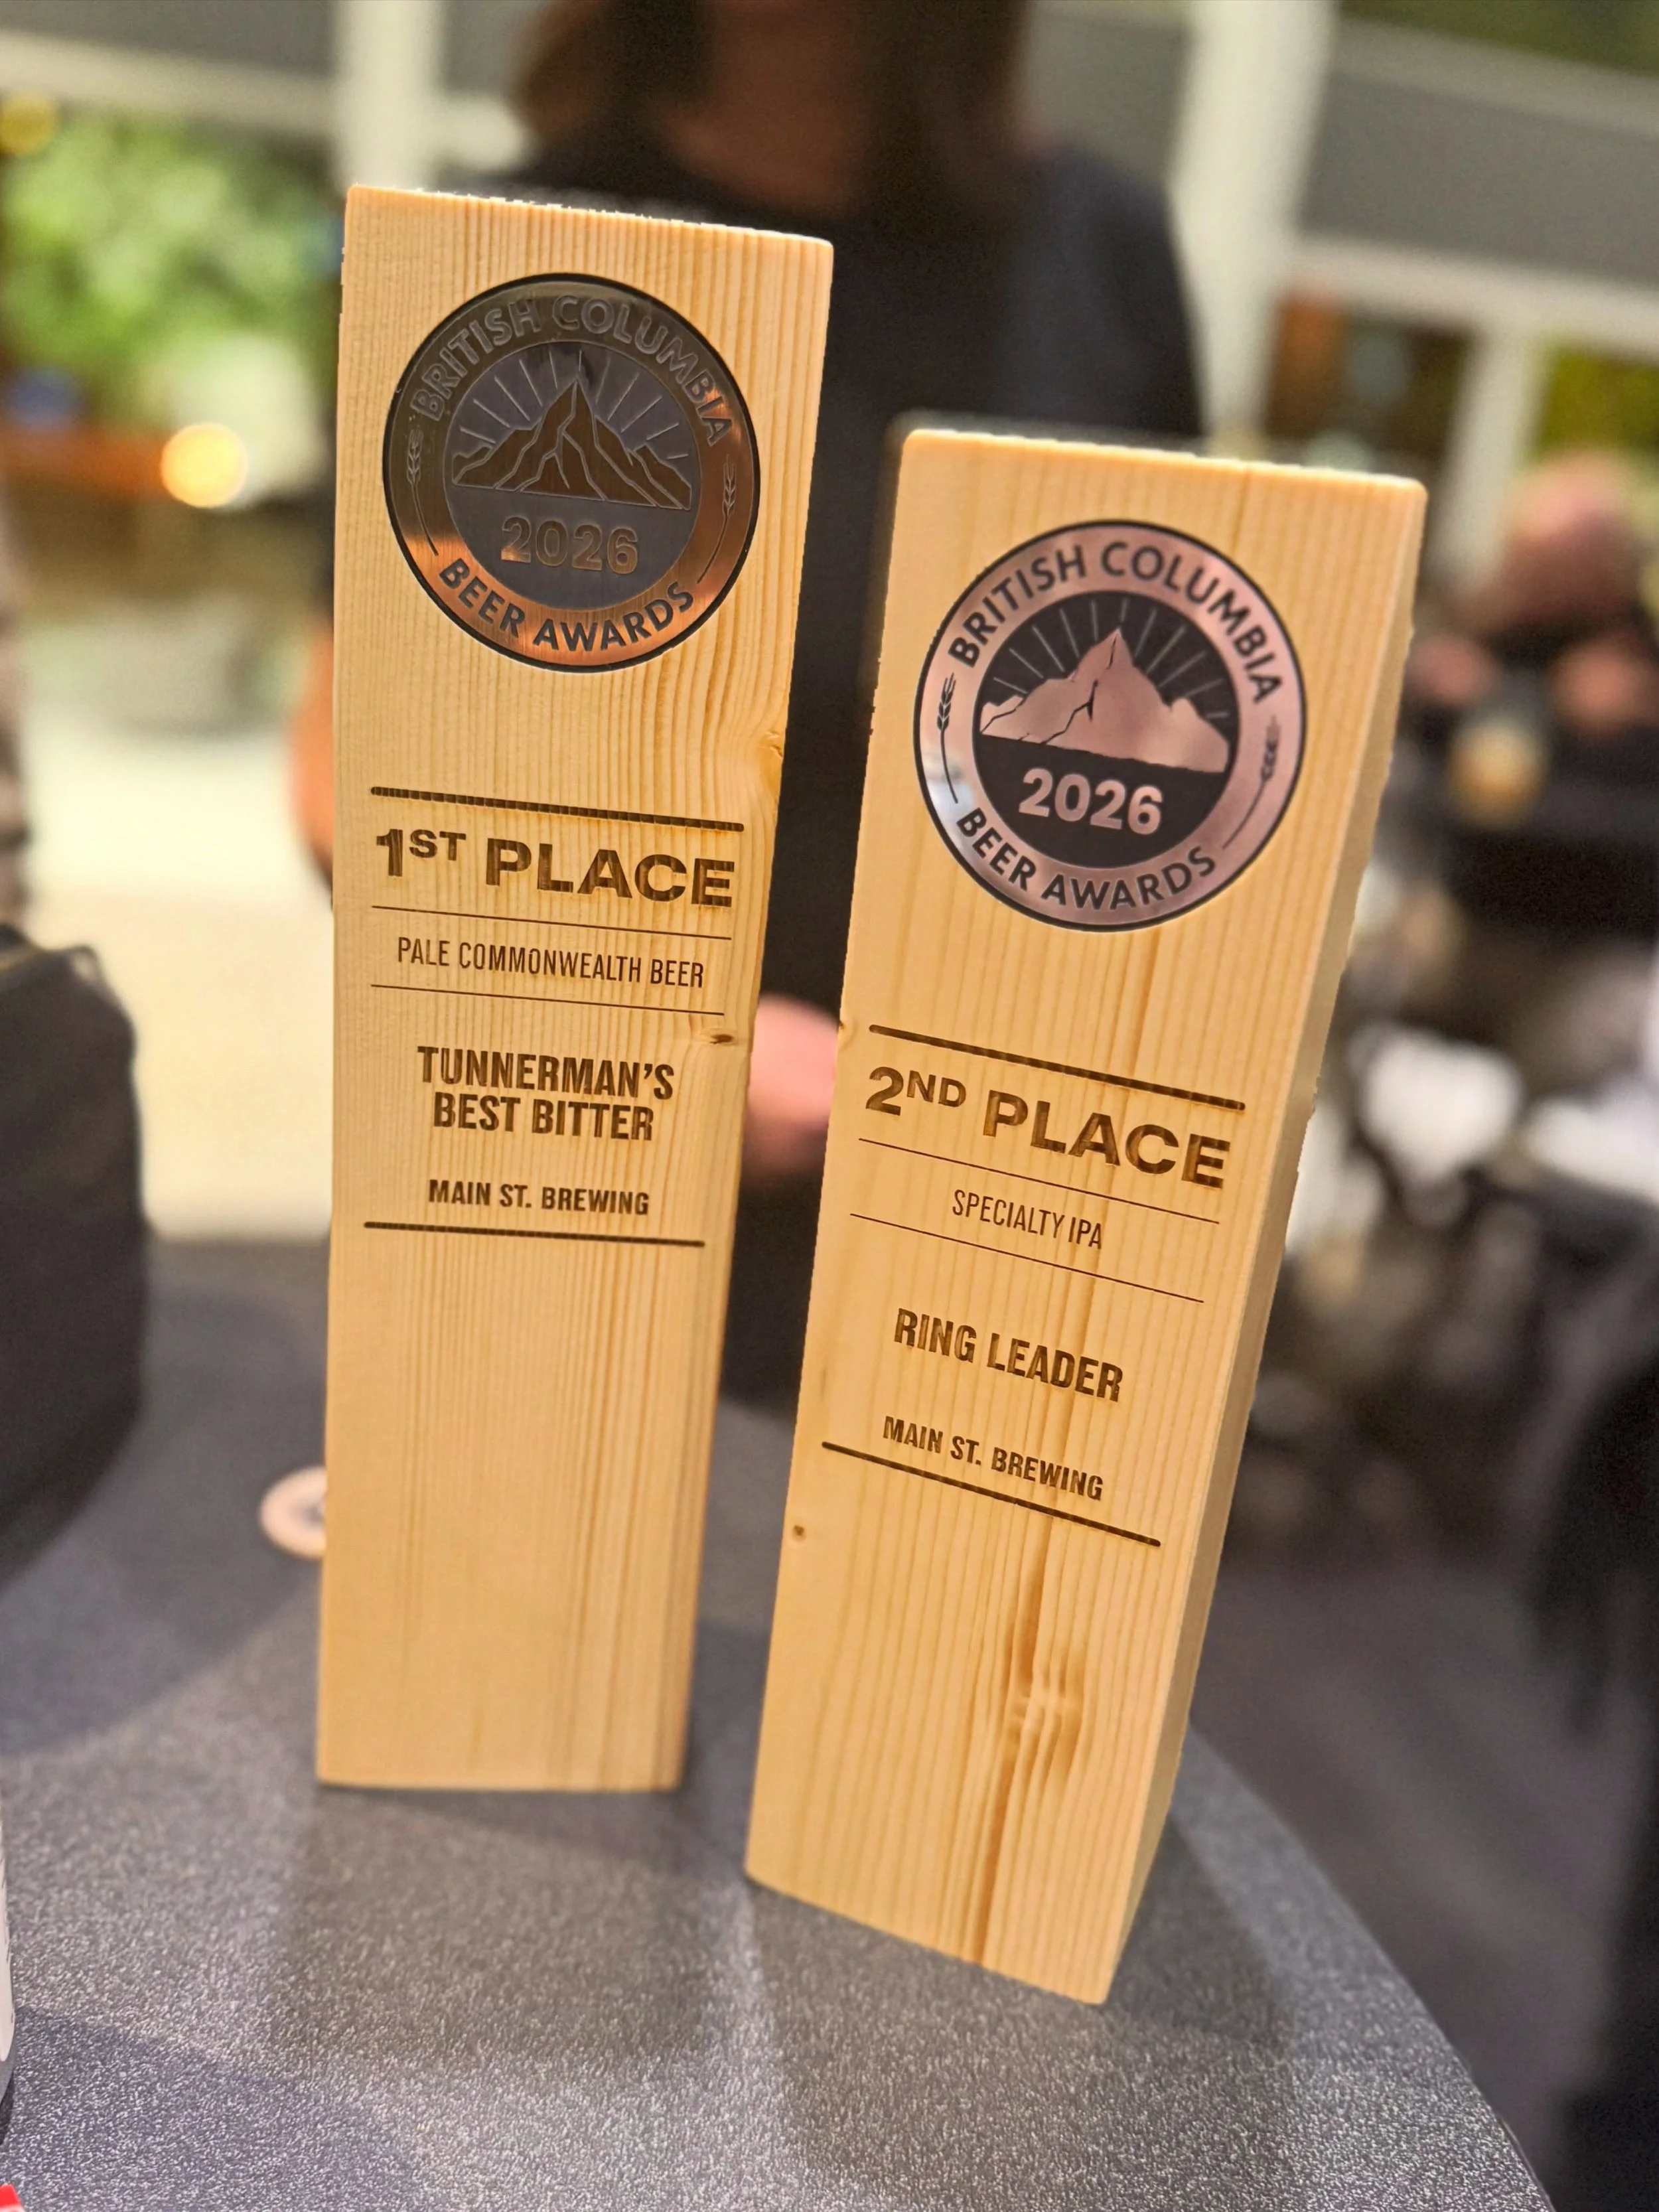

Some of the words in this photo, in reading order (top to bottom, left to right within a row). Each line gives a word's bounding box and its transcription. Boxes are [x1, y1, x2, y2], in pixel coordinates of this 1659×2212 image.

[411, 299, 541, 421] BRITISH
[552, 295, 732, 447] COLUMBIA
[501, 516, 638, 575] 2026
[439, 558, 525, 637] BEER
[533, 581, 693, 652] AWARDS
[948, 545, 1086, 668] BRITISH
[1102, 541, 1283, 703] COLUMBIA
[1019, 768, 1164, 834] 2026
[376, 828, 466, 877] 1ST
[486, 838, 735, 907] PLACE
[956, 808, 1037, 889] BEER
[1041, 846, 1215, 909] AWARDS
[397, 936, 450, 966] PALE
[459, 942, 641, 982] COMMONWEALTH
[650, 960, 704, 988] BEER
[417, 1046, 674, 1100] TUNNERMAN’S
[433, 1092, 520, 1132] BEST
[532, 1098, 654, 1141] BITTER
[865, 1067, 967, 1116] 2ND
[983, 1090, 1230, 1189] PLACE
[429, 1179, 491, 1207] MAIN
[500, 1185, 532, 1208] ST.
[541, 1187, 649, 1215] BREWING
[952, 1189, 1065, 1239] SPECIALTY
[1069, 1216, 1102, 1250] IPA
[894, 1308, 977, 1363] RING
[987, 1333, 1123, 1402] LEADER
[883, 1416, 944, 1454] MAIN
[950, 1435, 981, 1466] ST.
[991, 1447, 1104, 1501] BREWING
